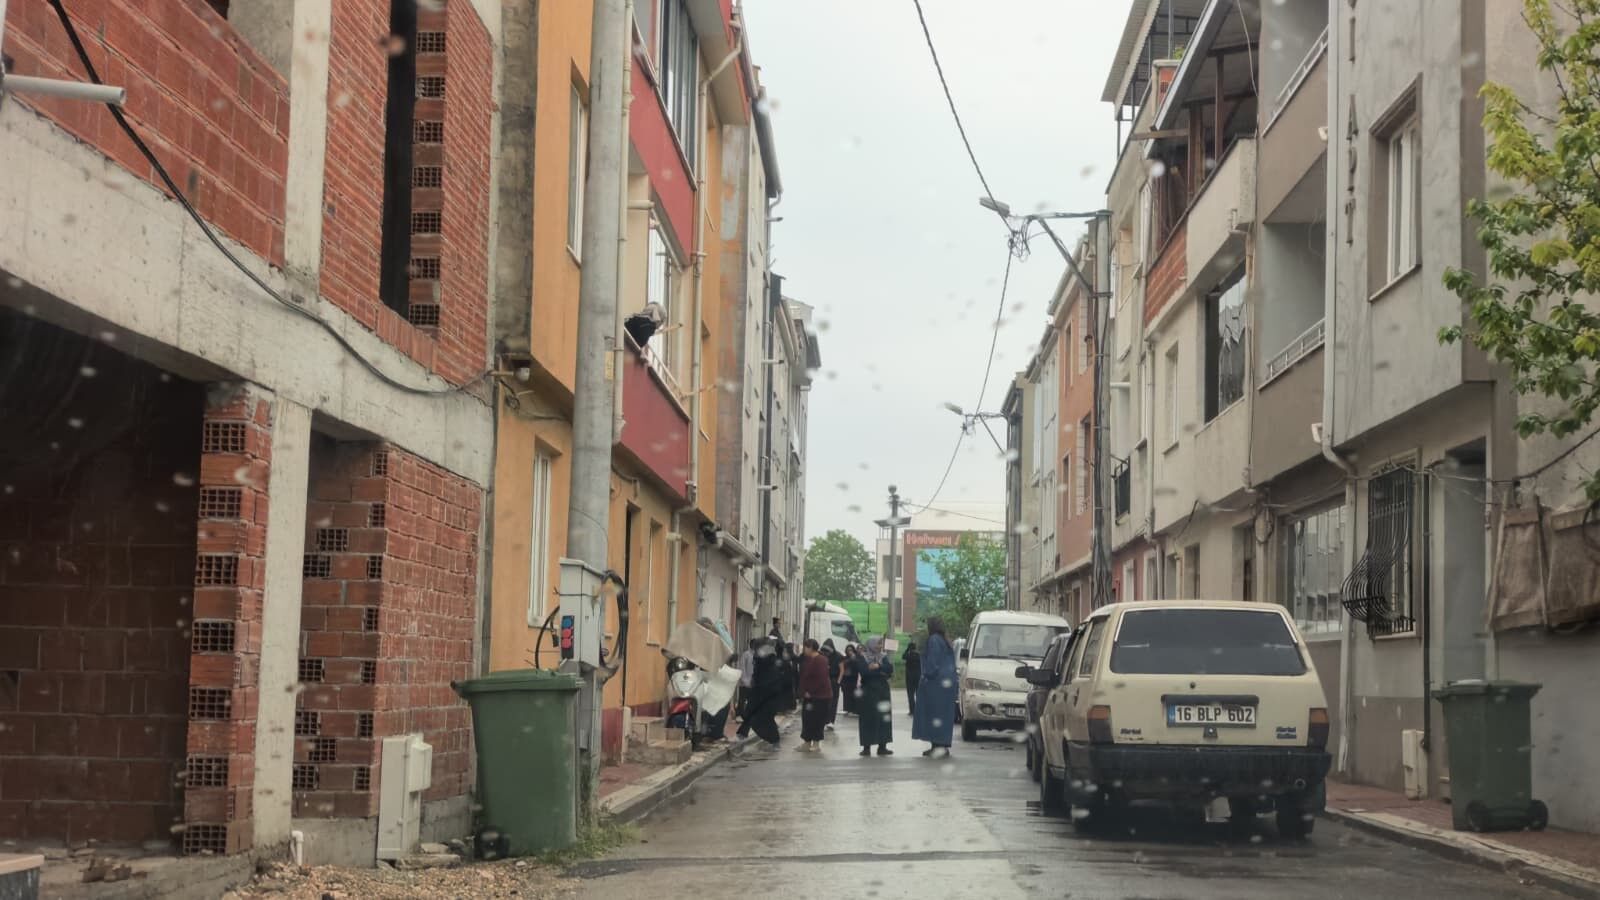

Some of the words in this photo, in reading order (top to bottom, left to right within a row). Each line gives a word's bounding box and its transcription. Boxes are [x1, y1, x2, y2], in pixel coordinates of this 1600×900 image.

[1177, 707, 1192, 721] 16
[1198, 707, 1222, 722] BLP
[1228, 708, 1253, 722] 602
